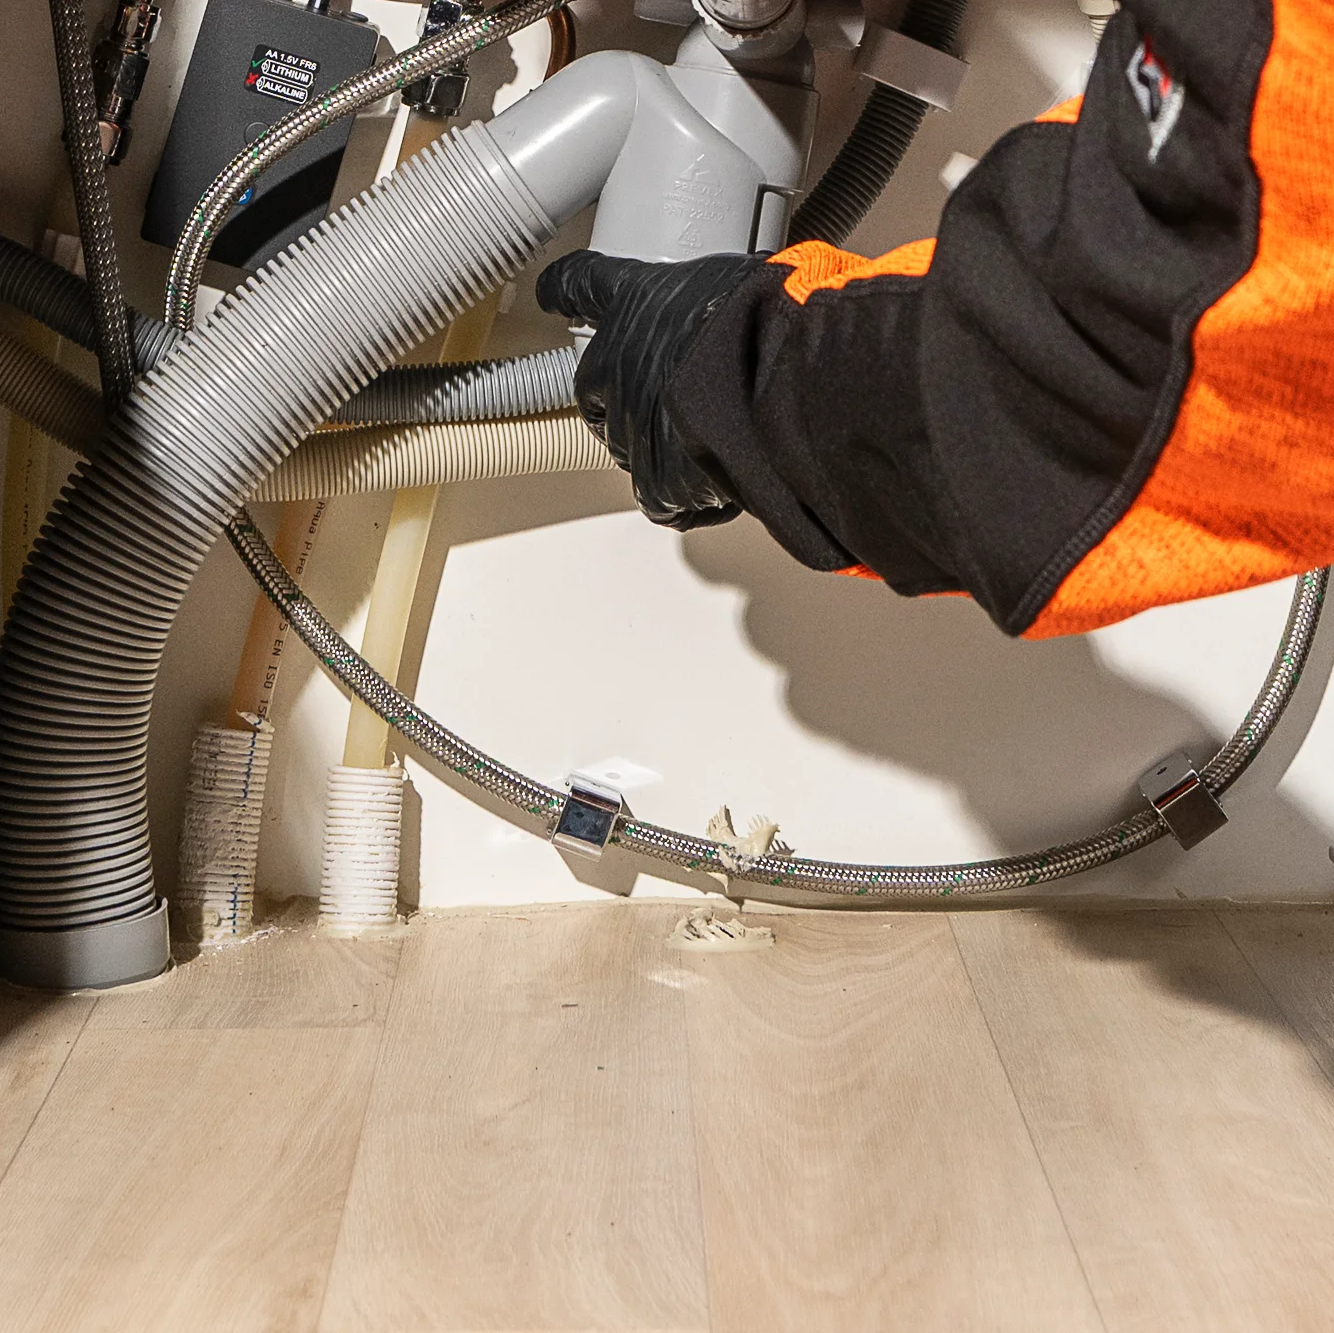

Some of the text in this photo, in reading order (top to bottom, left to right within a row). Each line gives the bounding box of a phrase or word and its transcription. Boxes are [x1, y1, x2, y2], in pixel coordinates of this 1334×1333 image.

[265, 49, 278, 60] AA
[280, 53, 299, 65] 1.5V
[270, 64, 310, 83] LITHIUM
[264, 80, 306, 100] ALKALINE
[308, 501, 326, 534] Aqua
[272, 639, 284, 656] EN
[264, 665, 278, 689] ISO
